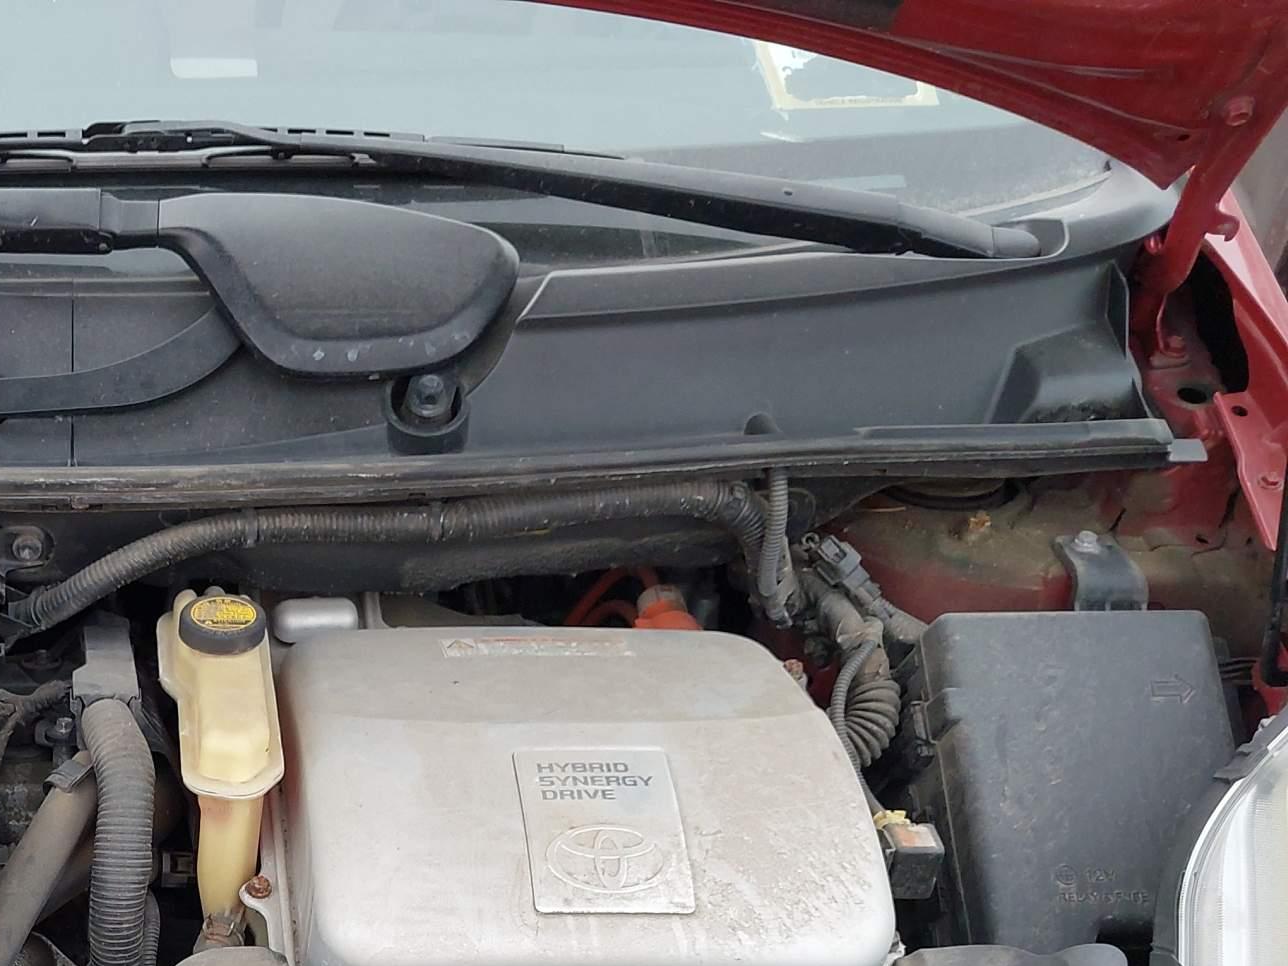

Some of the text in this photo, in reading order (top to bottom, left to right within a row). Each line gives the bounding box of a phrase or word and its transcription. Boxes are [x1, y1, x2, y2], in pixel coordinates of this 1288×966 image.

[537, 762, 629, 773] HYBRID
[538, 775, 653, 787] SYNERGY
[541, 789, 616, 801] DRIVE
